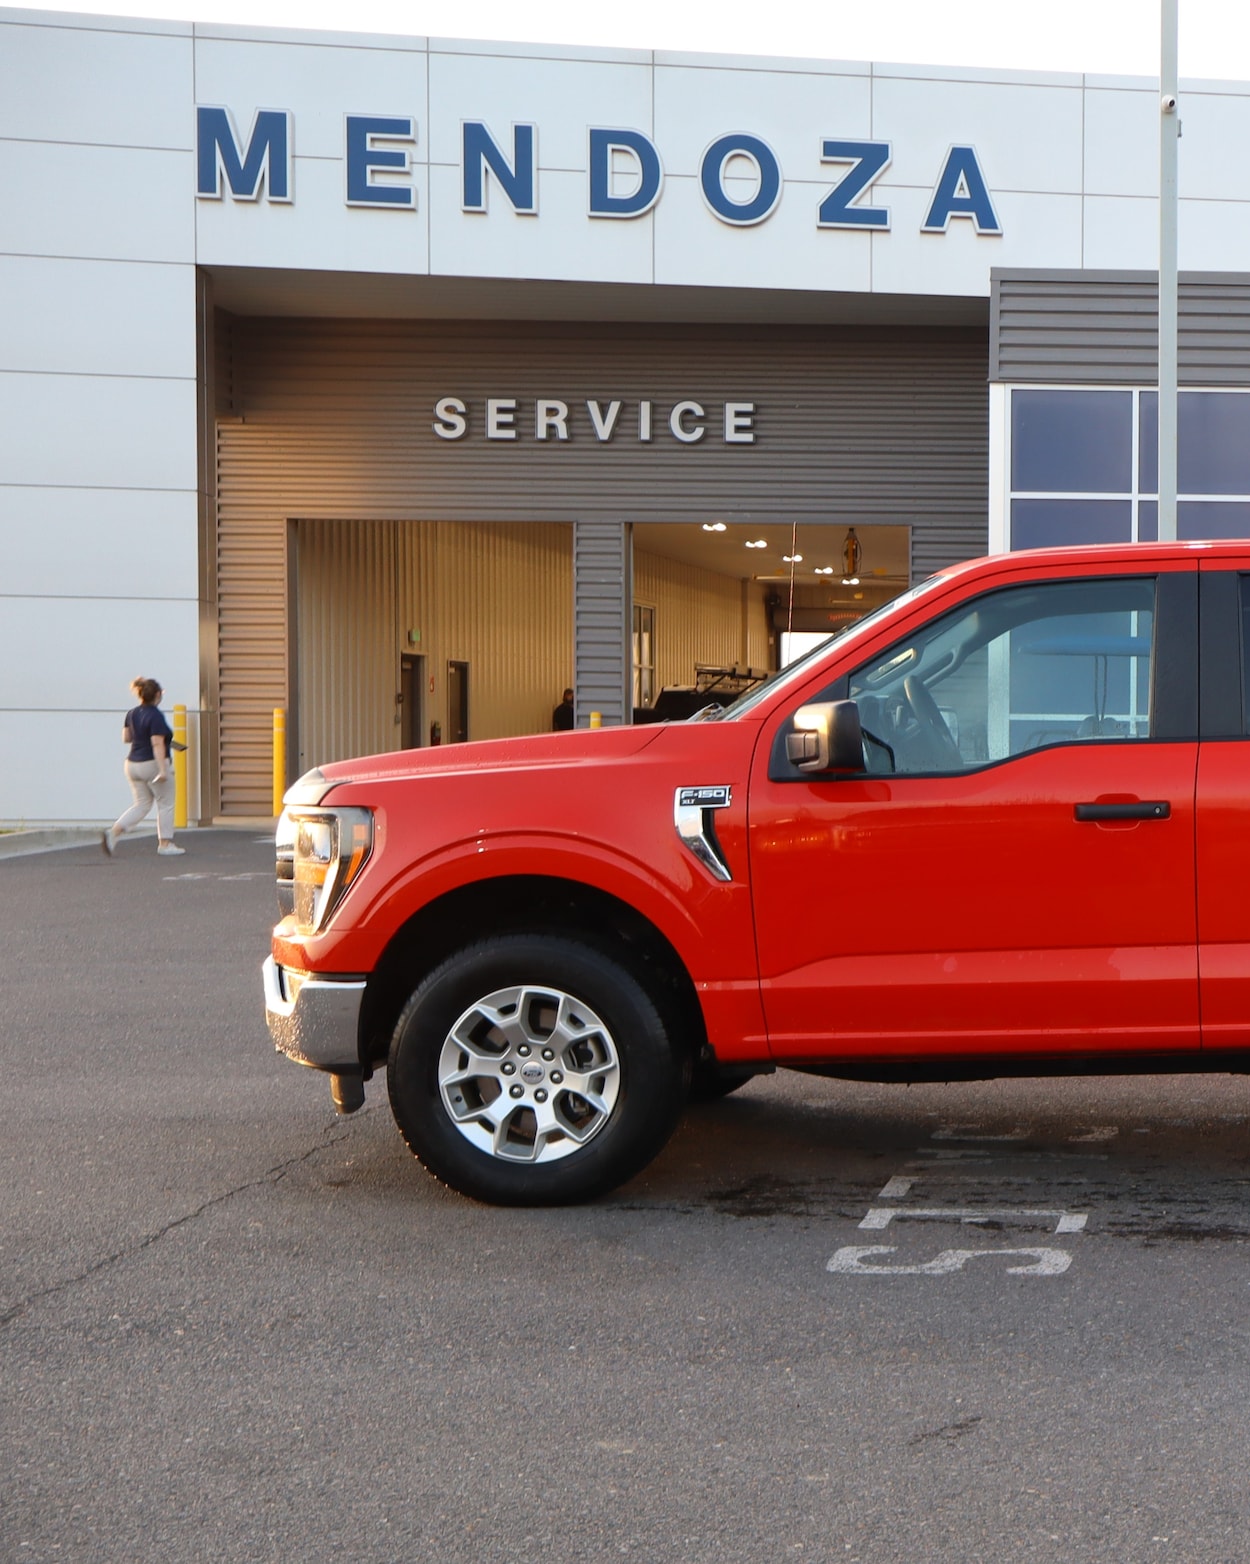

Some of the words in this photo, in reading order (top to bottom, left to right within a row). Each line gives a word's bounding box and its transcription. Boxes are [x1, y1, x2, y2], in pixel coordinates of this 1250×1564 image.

[196, 105, 1003, 236] MENDOZA
[432, 397, 759, 445] SERVICE
[681, 790, 724, 799] F-150
